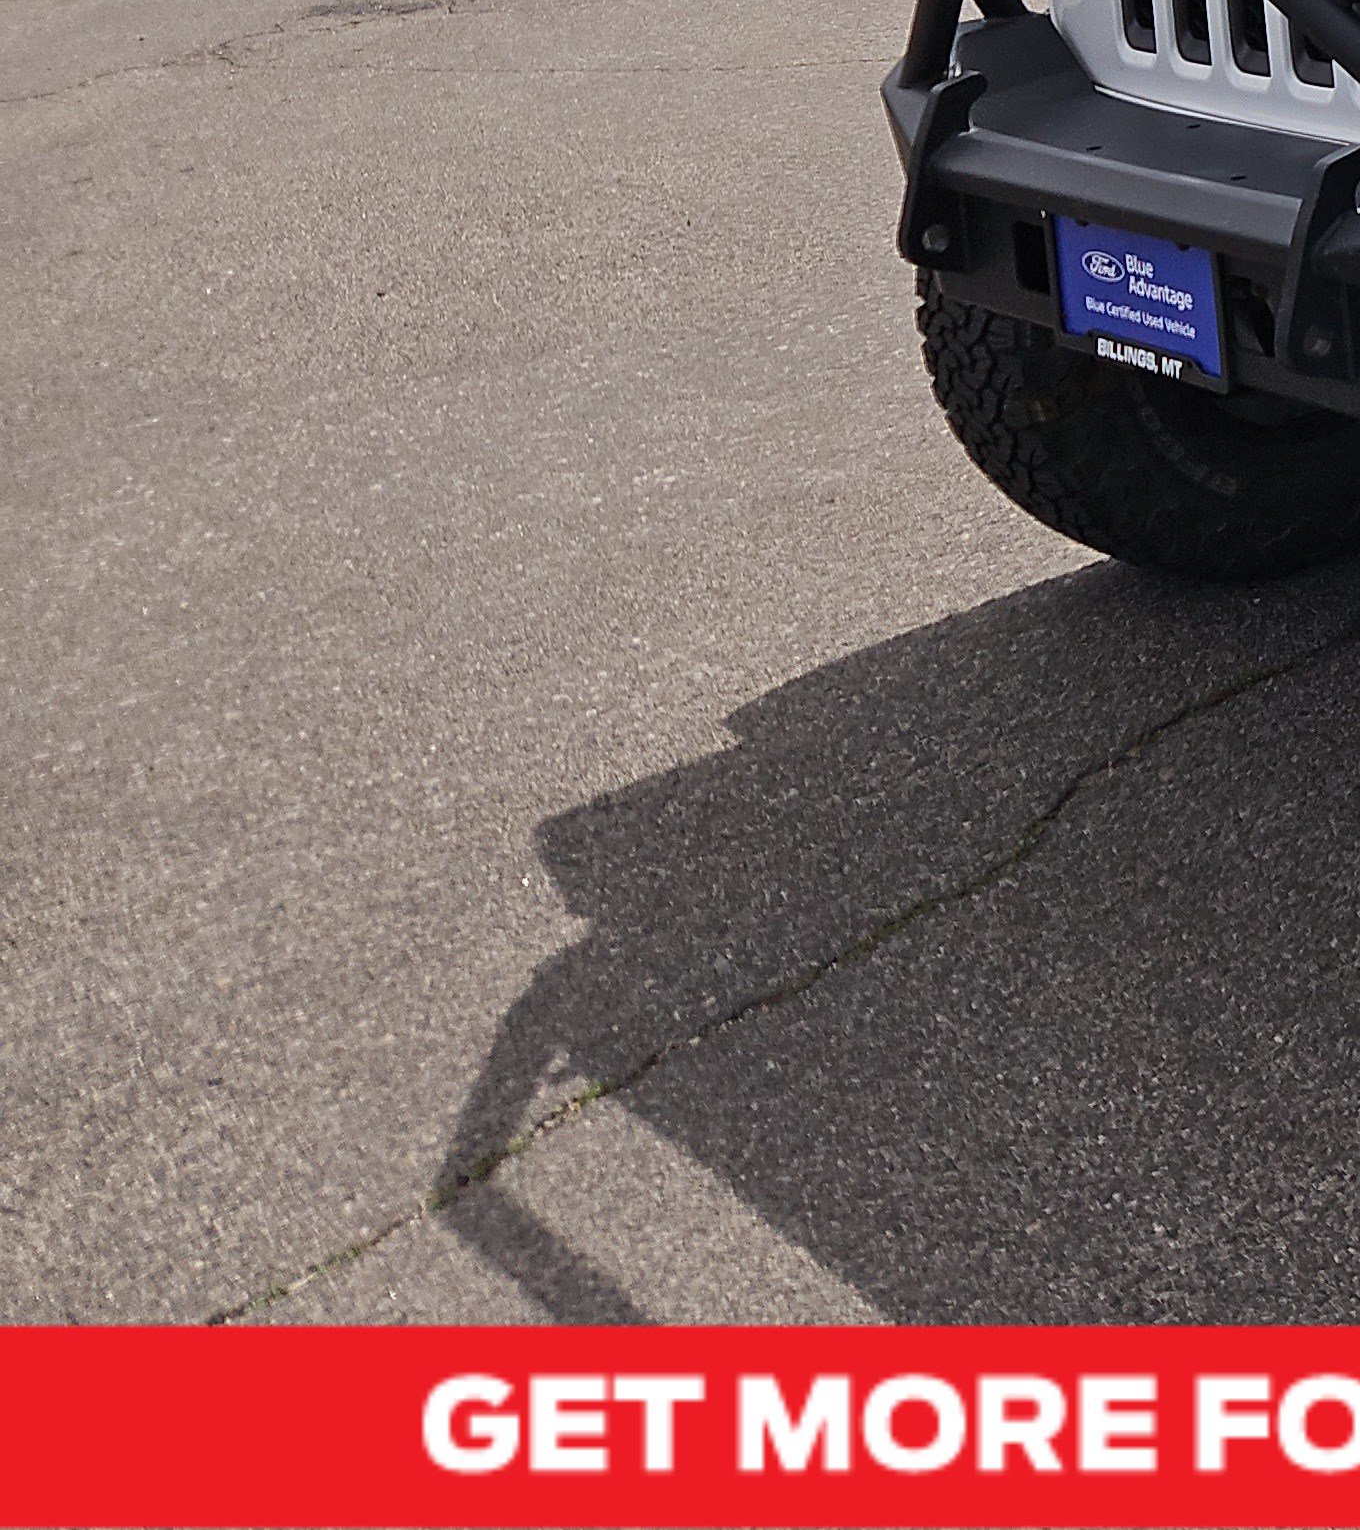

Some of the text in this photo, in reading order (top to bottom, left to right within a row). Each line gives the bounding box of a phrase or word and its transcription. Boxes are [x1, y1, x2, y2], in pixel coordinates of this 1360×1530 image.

[1089, 254, 1117, 278] Ford
[1125, 253, 1154, 279] Blue
[1129, 276, 1194, 311] Advantage
[1085, 296, 1197, 339] Blue Certified Used Vehicle
[1097, 338, 1183, 379] BILLINGS, MT
